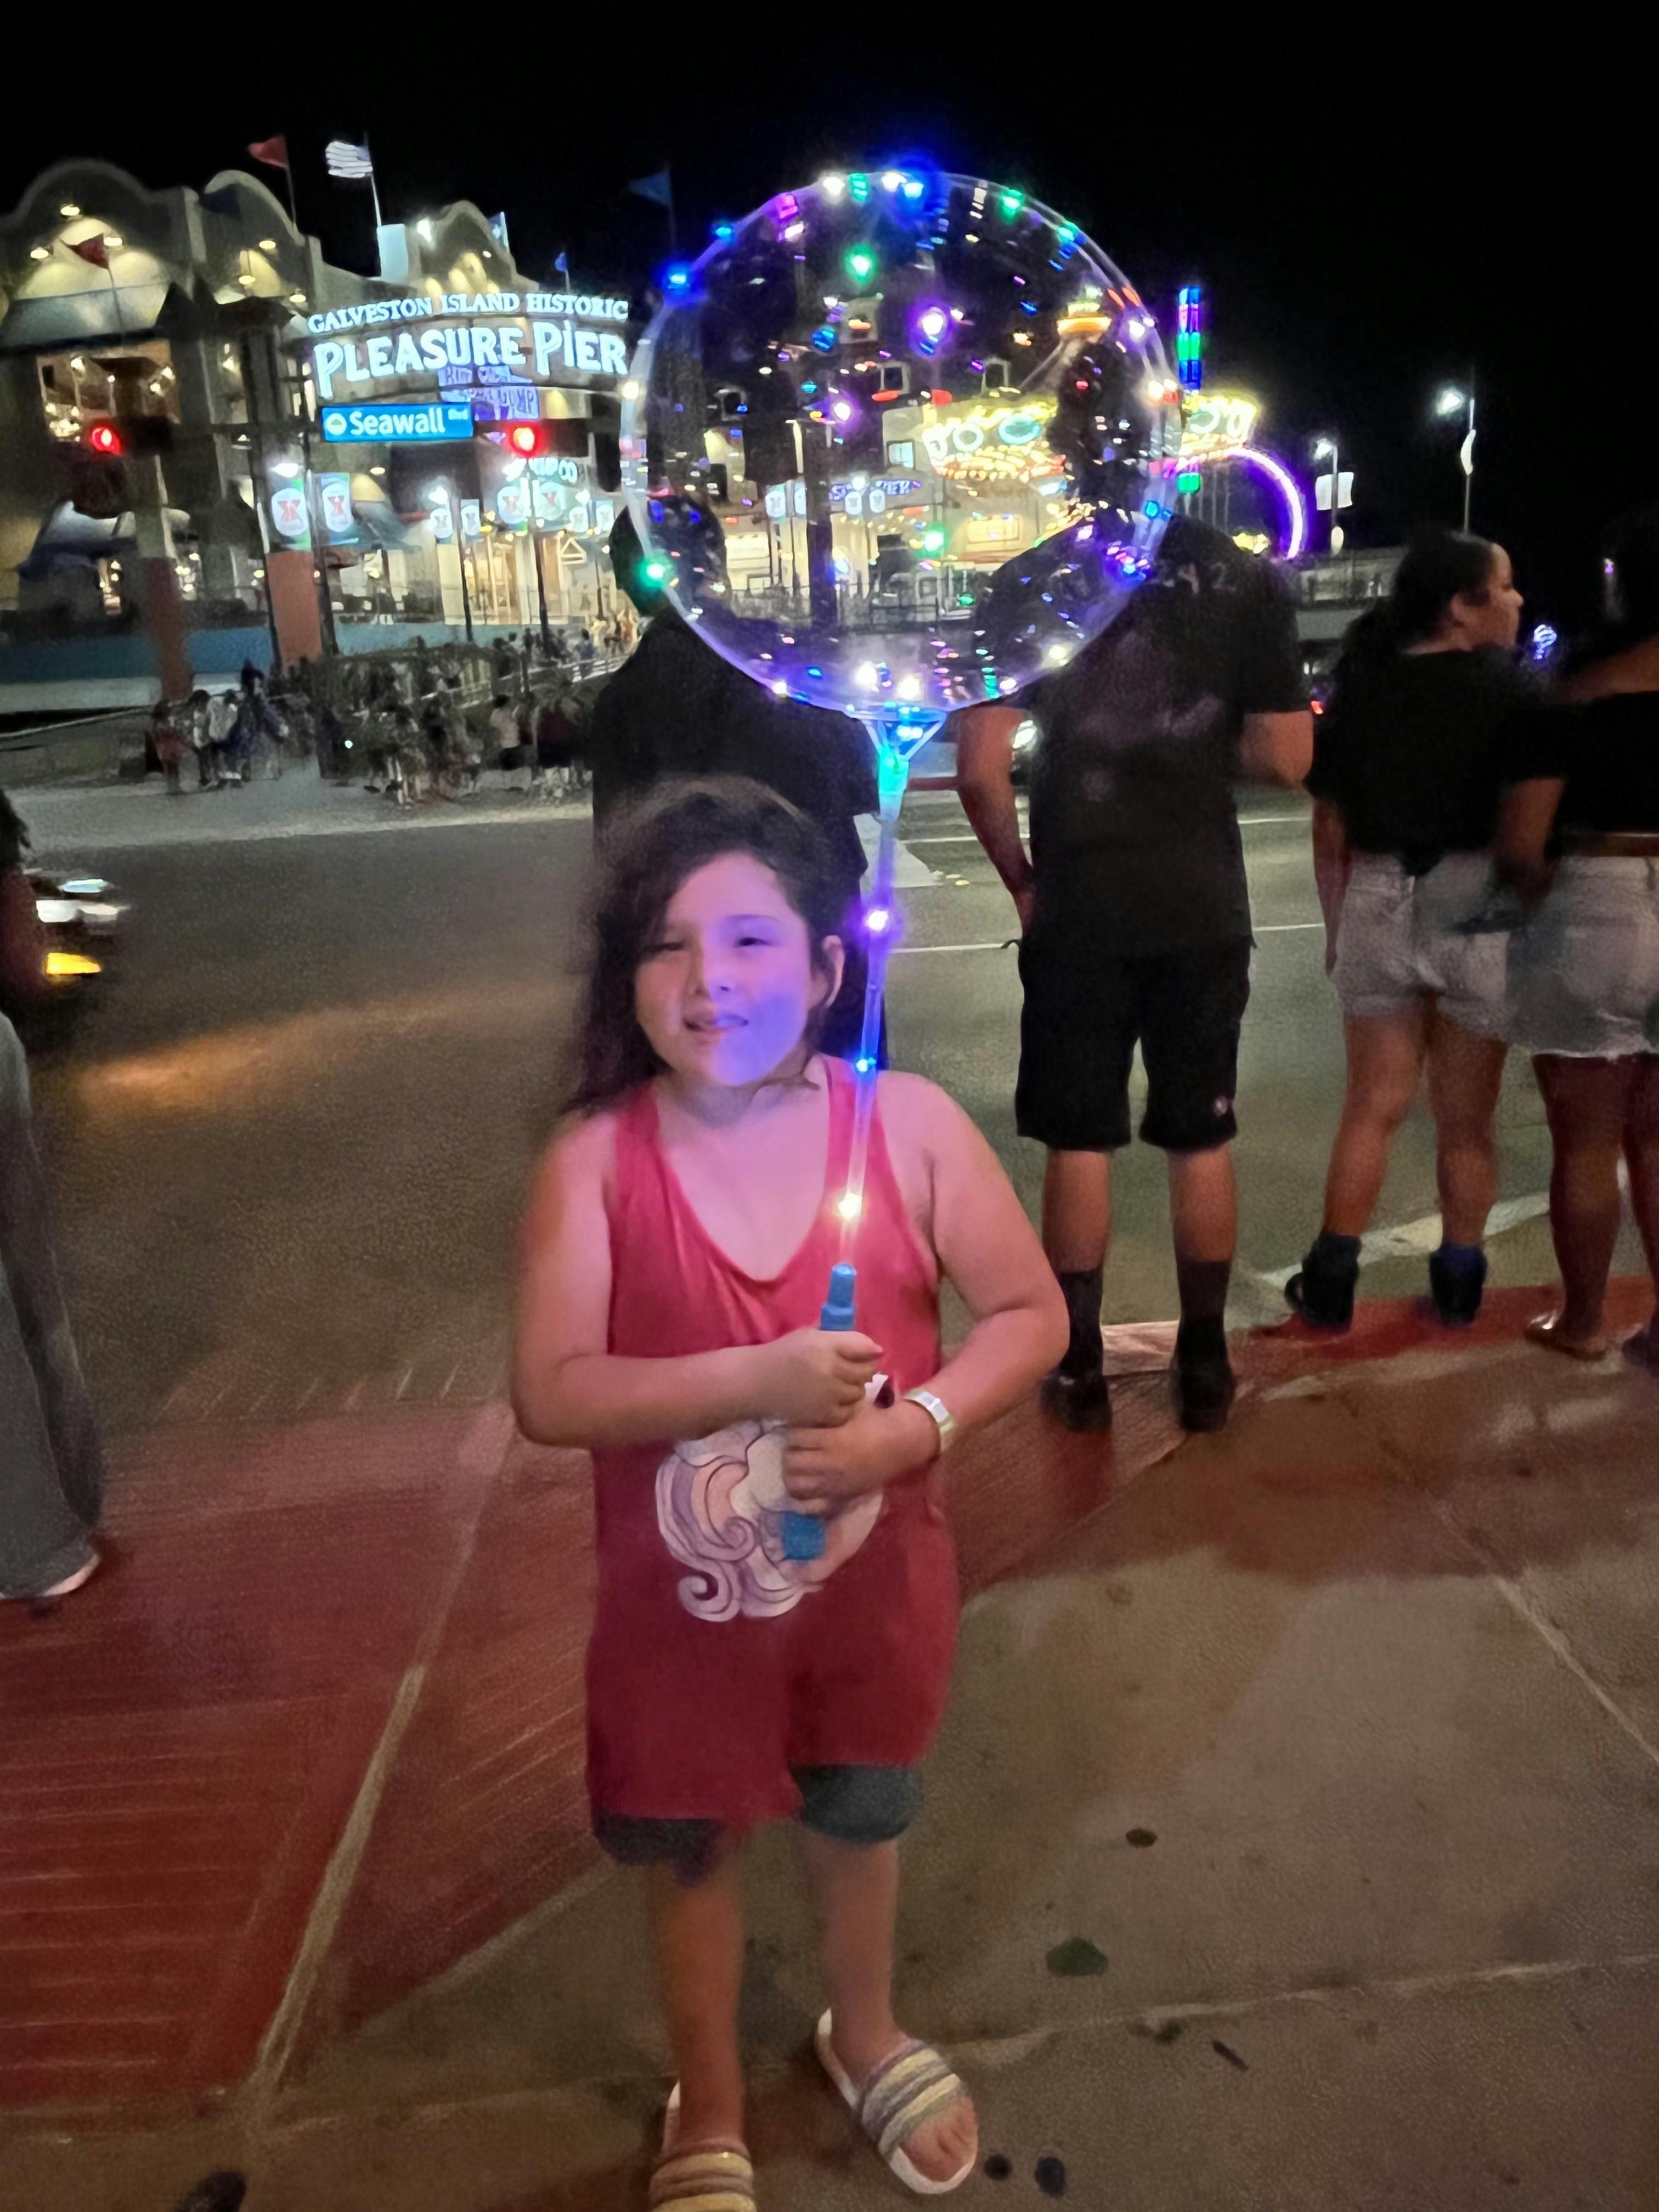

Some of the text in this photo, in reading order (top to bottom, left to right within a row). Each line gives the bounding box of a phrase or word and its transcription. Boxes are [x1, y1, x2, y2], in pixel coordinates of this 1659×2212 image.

[307, 292, 629, 334] GALVESTON ISLAND HISTORIC
[313, 320, 629, 400] PLEASURE PIER
[349, 407, 446, 436] Seawall
